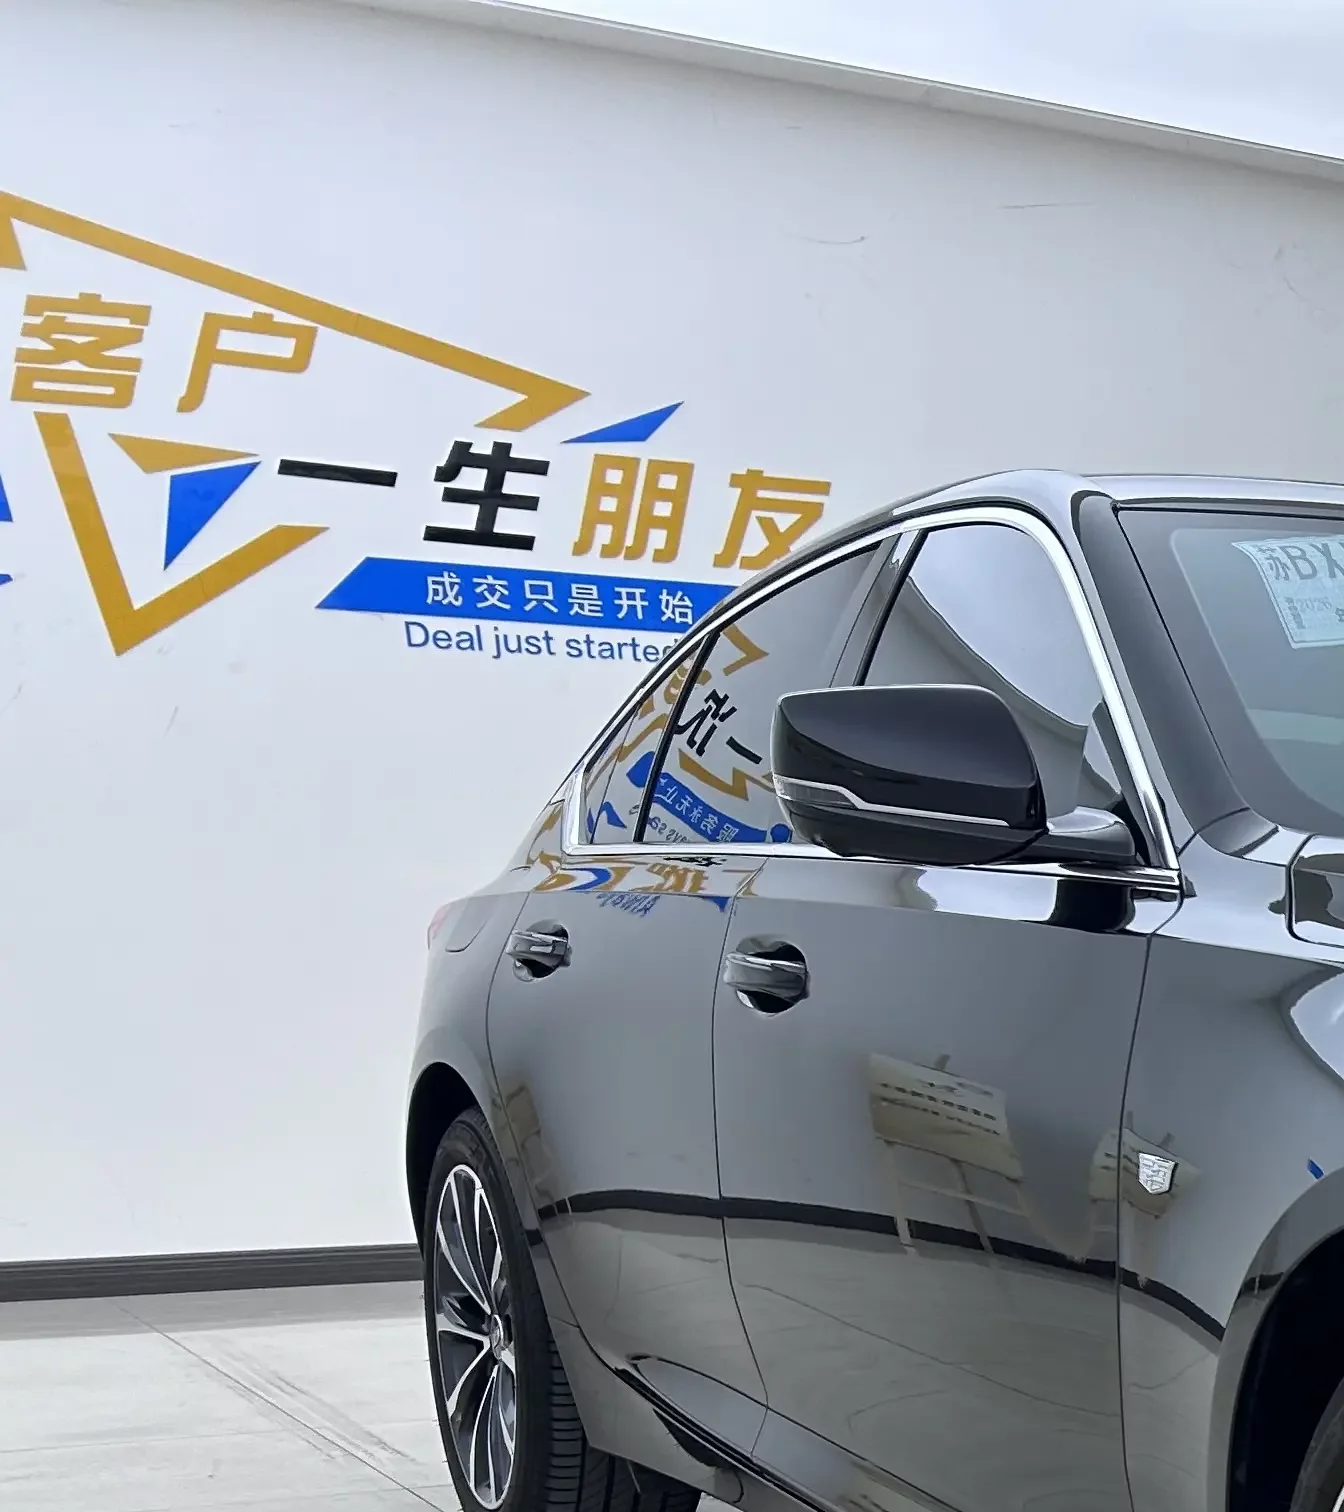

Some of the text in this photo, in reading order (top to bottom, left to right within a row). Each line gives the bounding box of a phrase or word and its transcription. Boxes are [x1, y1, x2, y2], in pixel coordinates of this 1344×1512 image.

[11, 292, 318, 413] 客户
[277, 440, 832, 569] 一生朋友
[404, 621, 483, 652] Deal
[492, 626, 556, 660] just
[426, 571, 693, 625] 成交只是开始
